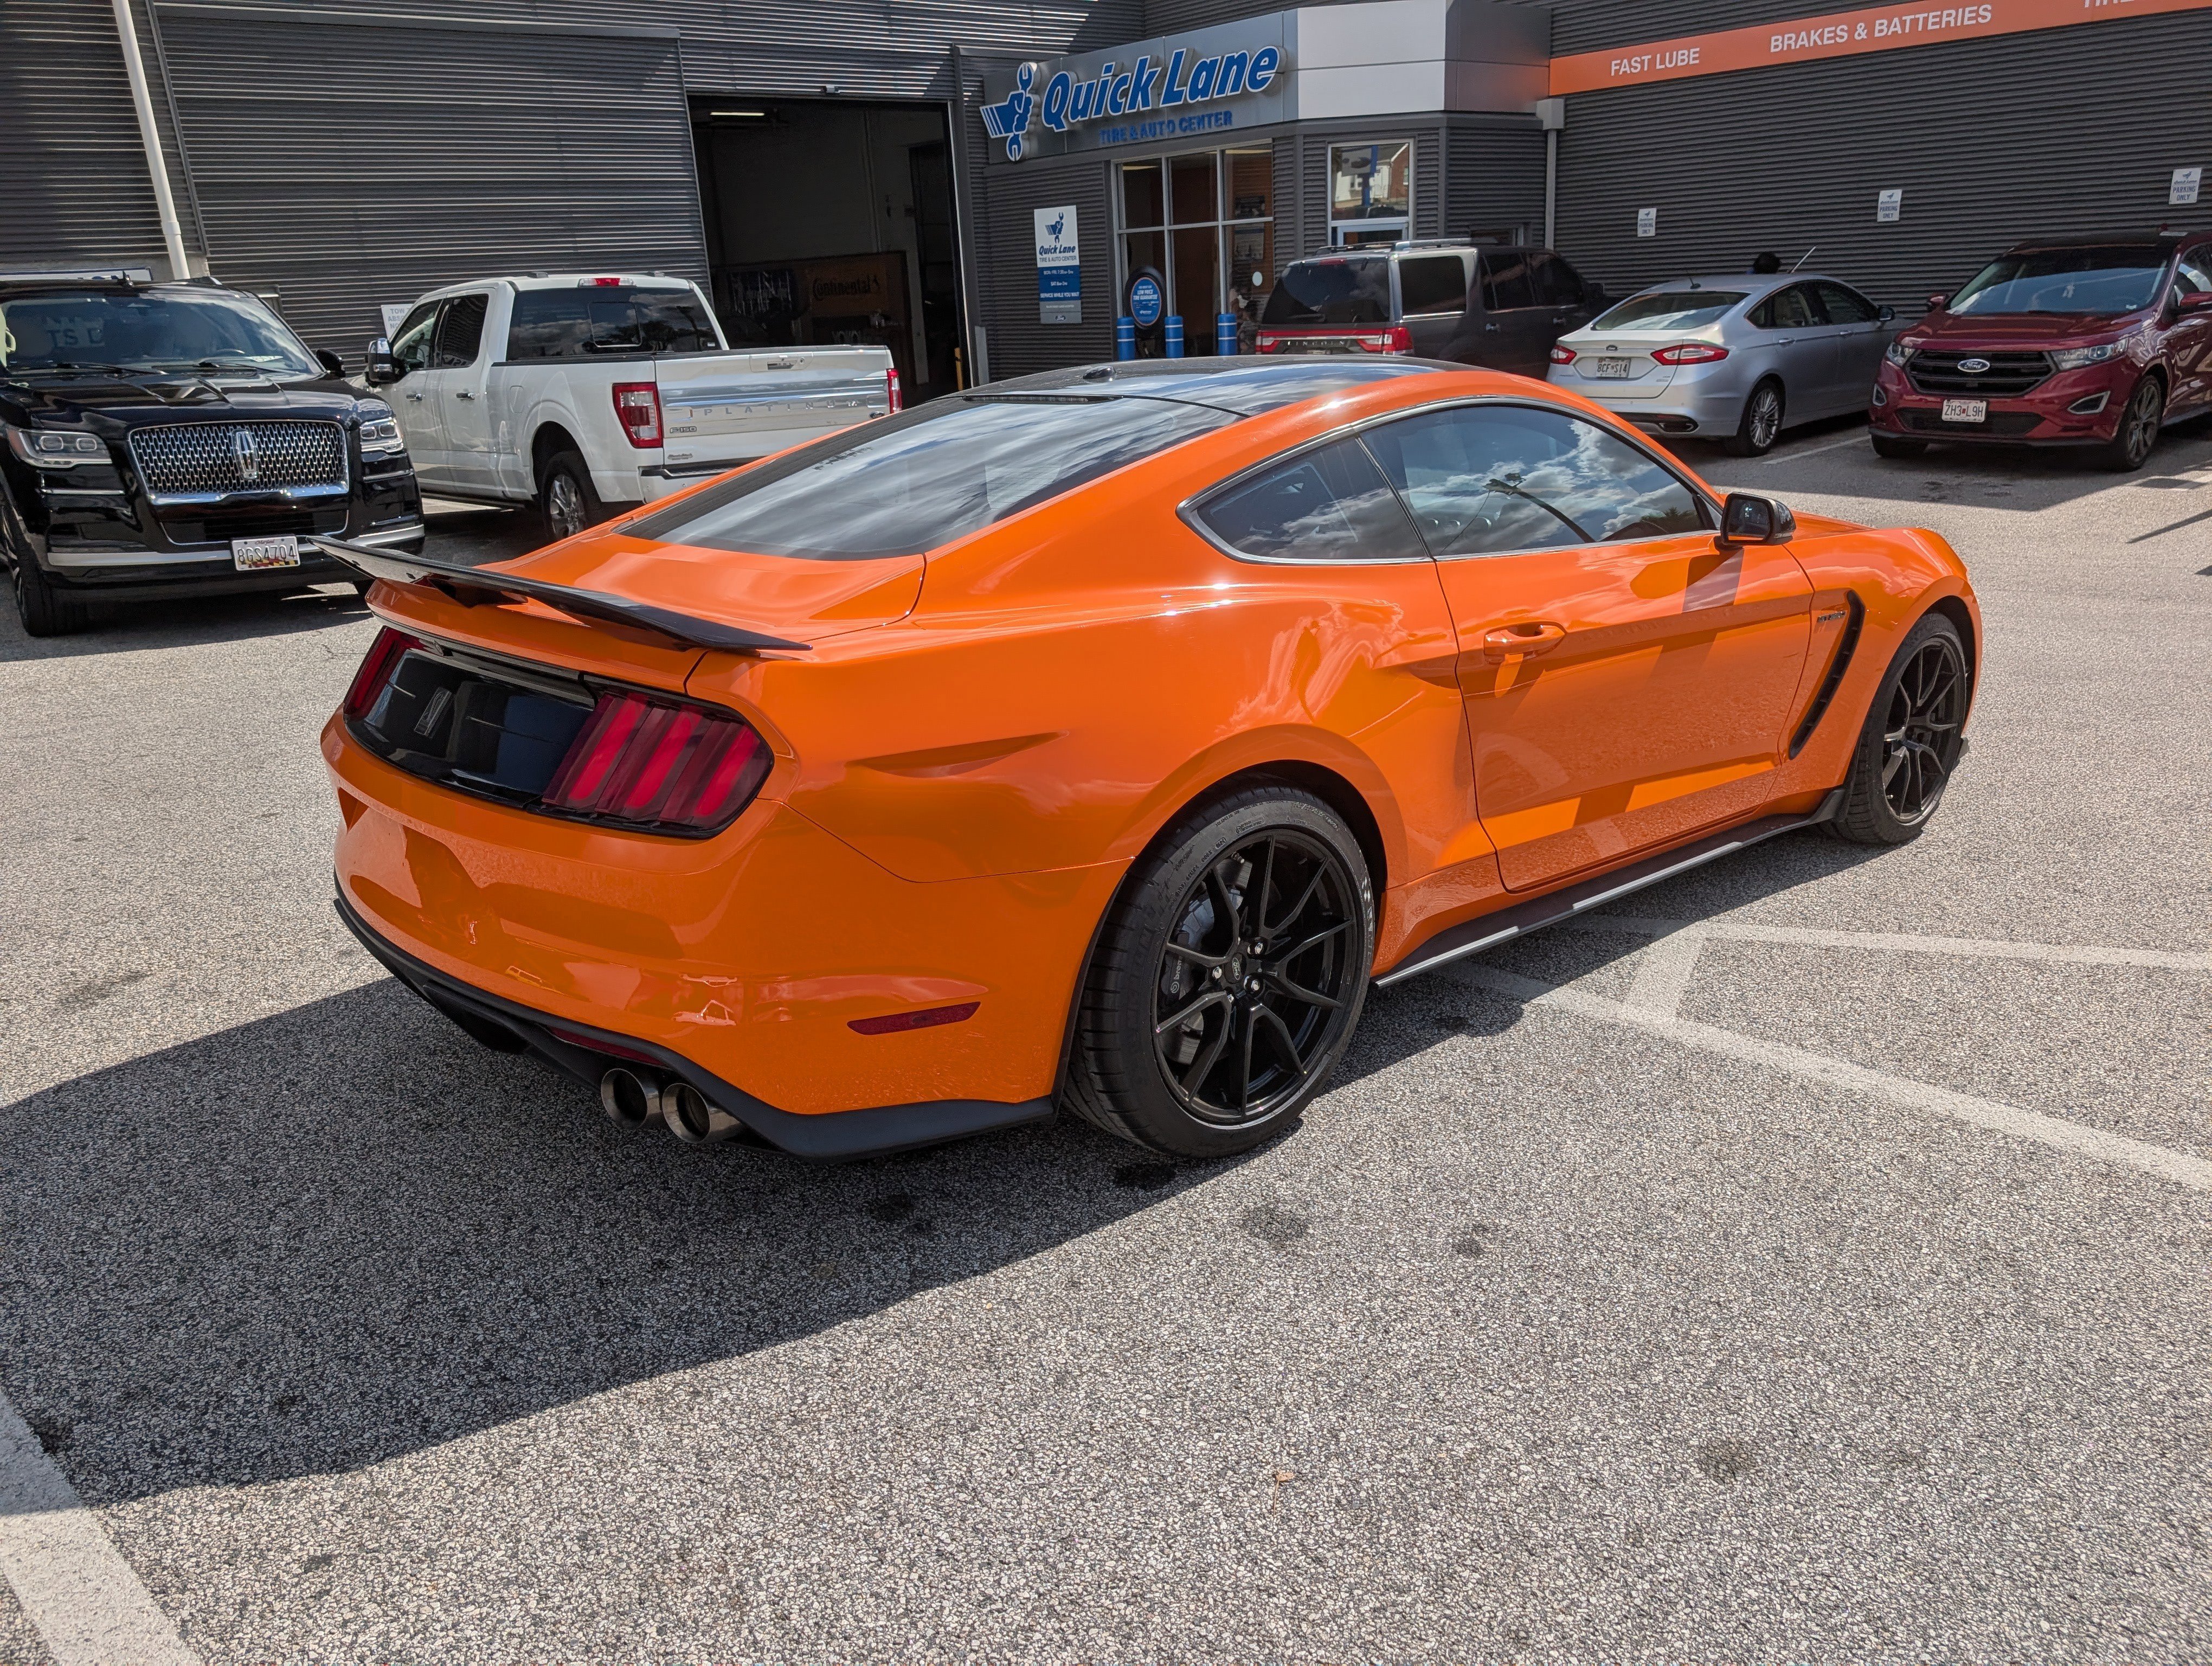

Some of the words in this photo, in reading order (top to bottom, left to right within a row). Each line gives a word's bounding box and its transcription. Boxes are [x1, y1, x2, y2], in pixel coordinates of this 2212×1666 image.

[1770, 25, 1848, 53] BRAKES
[1854, 22, 1868, 40] &
[1874, 4, 1992, 38] BATTERIES
[1610, 55, 1652, 76] FAST
[1655, 48, 1700, 69] LUBE
[1042, 55, 1161, 132] Quick
[1159, 46, 1281, 108] Lane
[1099, 129, 1127, 145] TIRE
[1129, 125, 1137, 140] &
[1140, 122, 1175, 139] AUTO
[1179, 110, 1233, 133] CENTER
[1039, 244, 1058, 256] Quick
[1058, 244, 1076, 254] Lane
[1964, 361, 1983, 369] Ford
[704, 399, 858, 416] PLATINUM
[237, 544, 298, 563] 8GS4704
